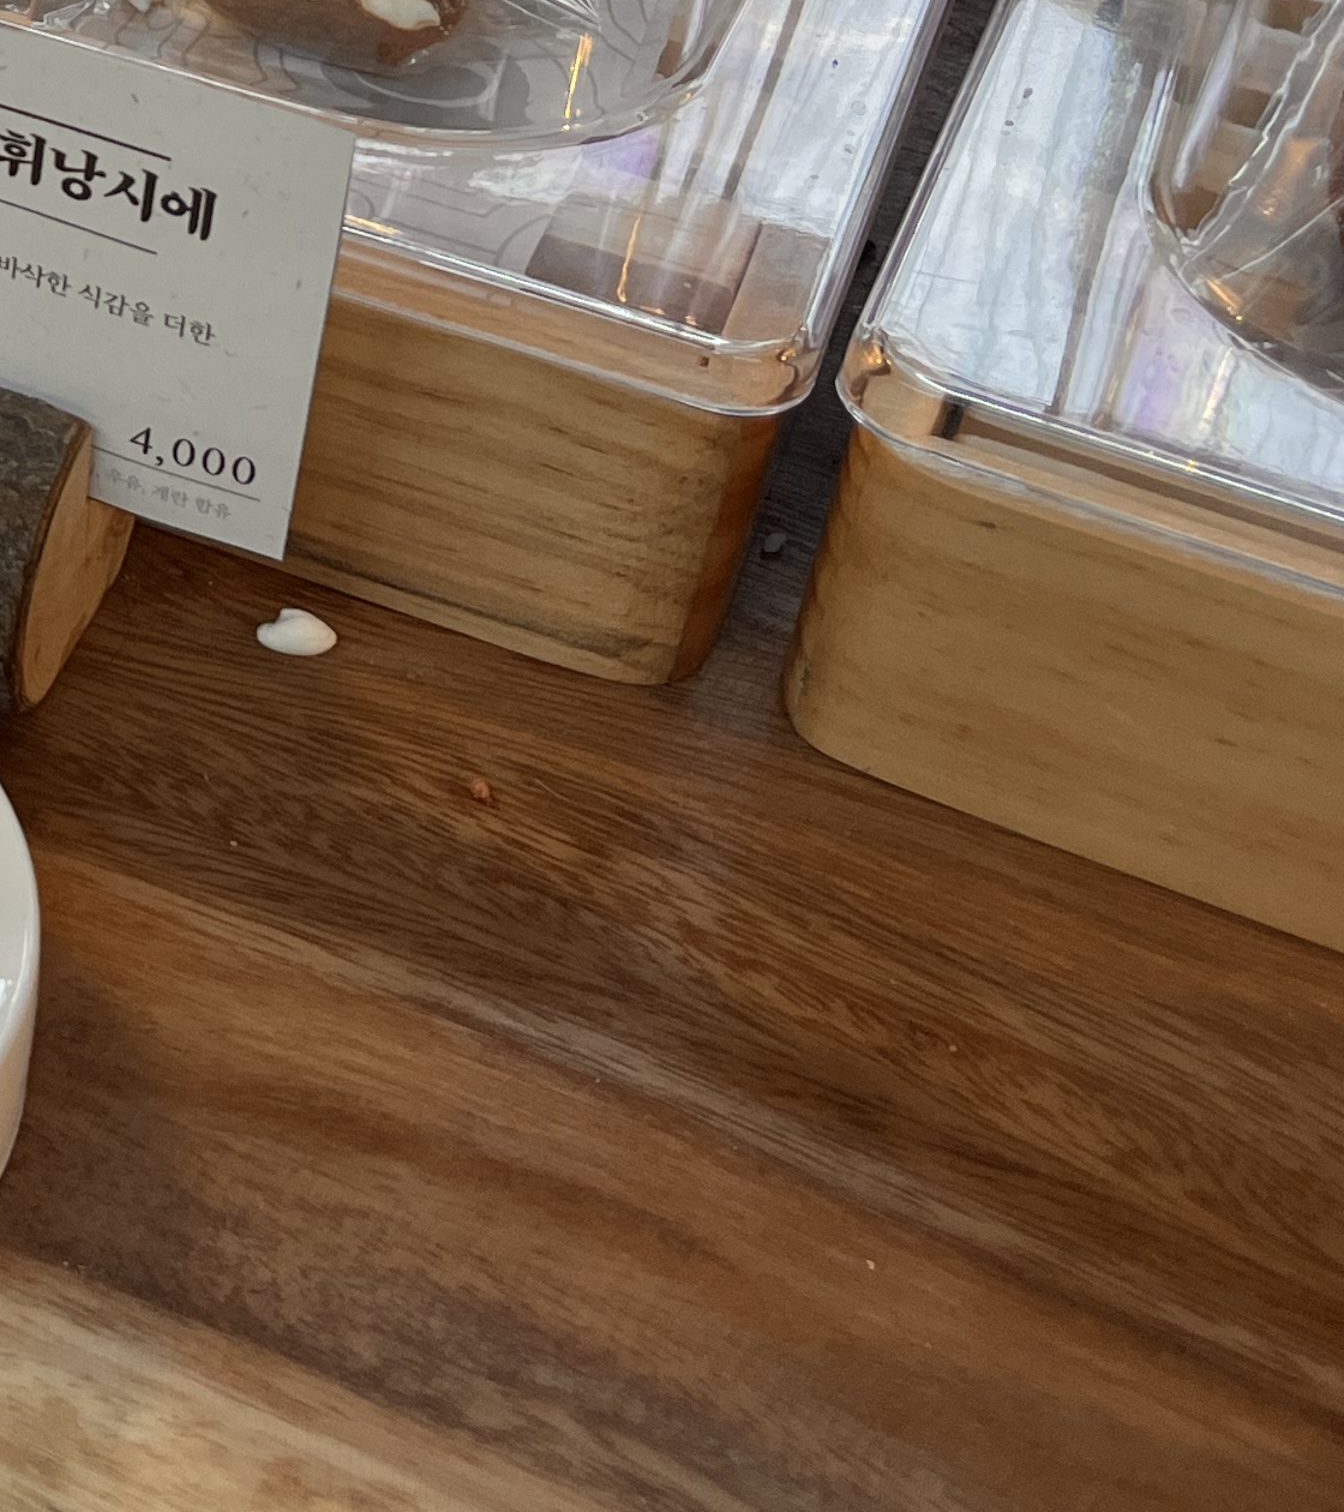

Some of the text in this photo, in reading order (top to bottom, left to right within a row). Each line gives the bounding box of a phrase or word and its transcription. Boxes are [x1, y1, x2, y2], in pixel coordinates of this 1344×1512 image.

[78, 283, 154, 327] 식감을
[163, 312, 216, 346] 더한
[129, 426, 256, 486] 4,000
